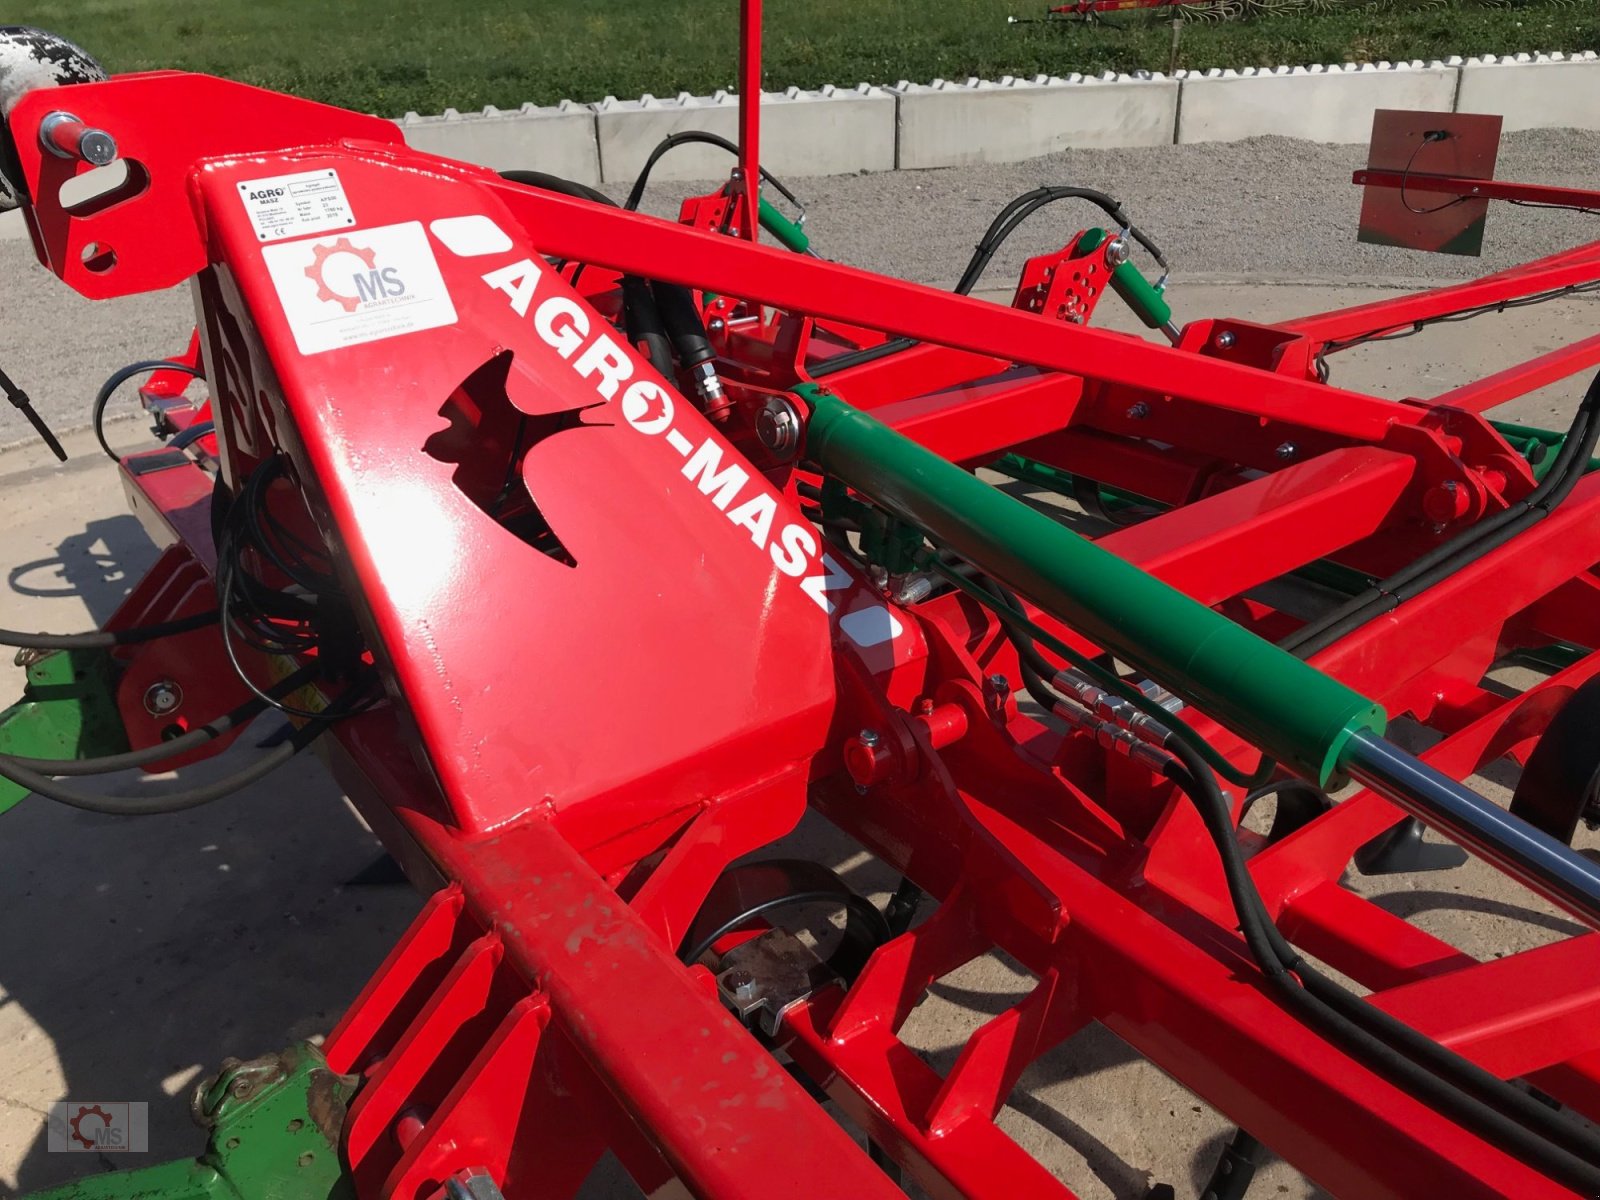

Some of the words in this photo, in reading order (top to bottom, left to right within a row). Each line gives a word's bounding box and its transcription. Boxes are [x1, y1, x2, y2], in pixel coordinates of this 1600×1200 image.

[249, 187, 285, 201] AGRO
[259, 197, 280, 205] MASZ
[364, 294, 416, 309] AGRARTECHNIK
[480, 258, 854, 614] AGRO-MASZ
